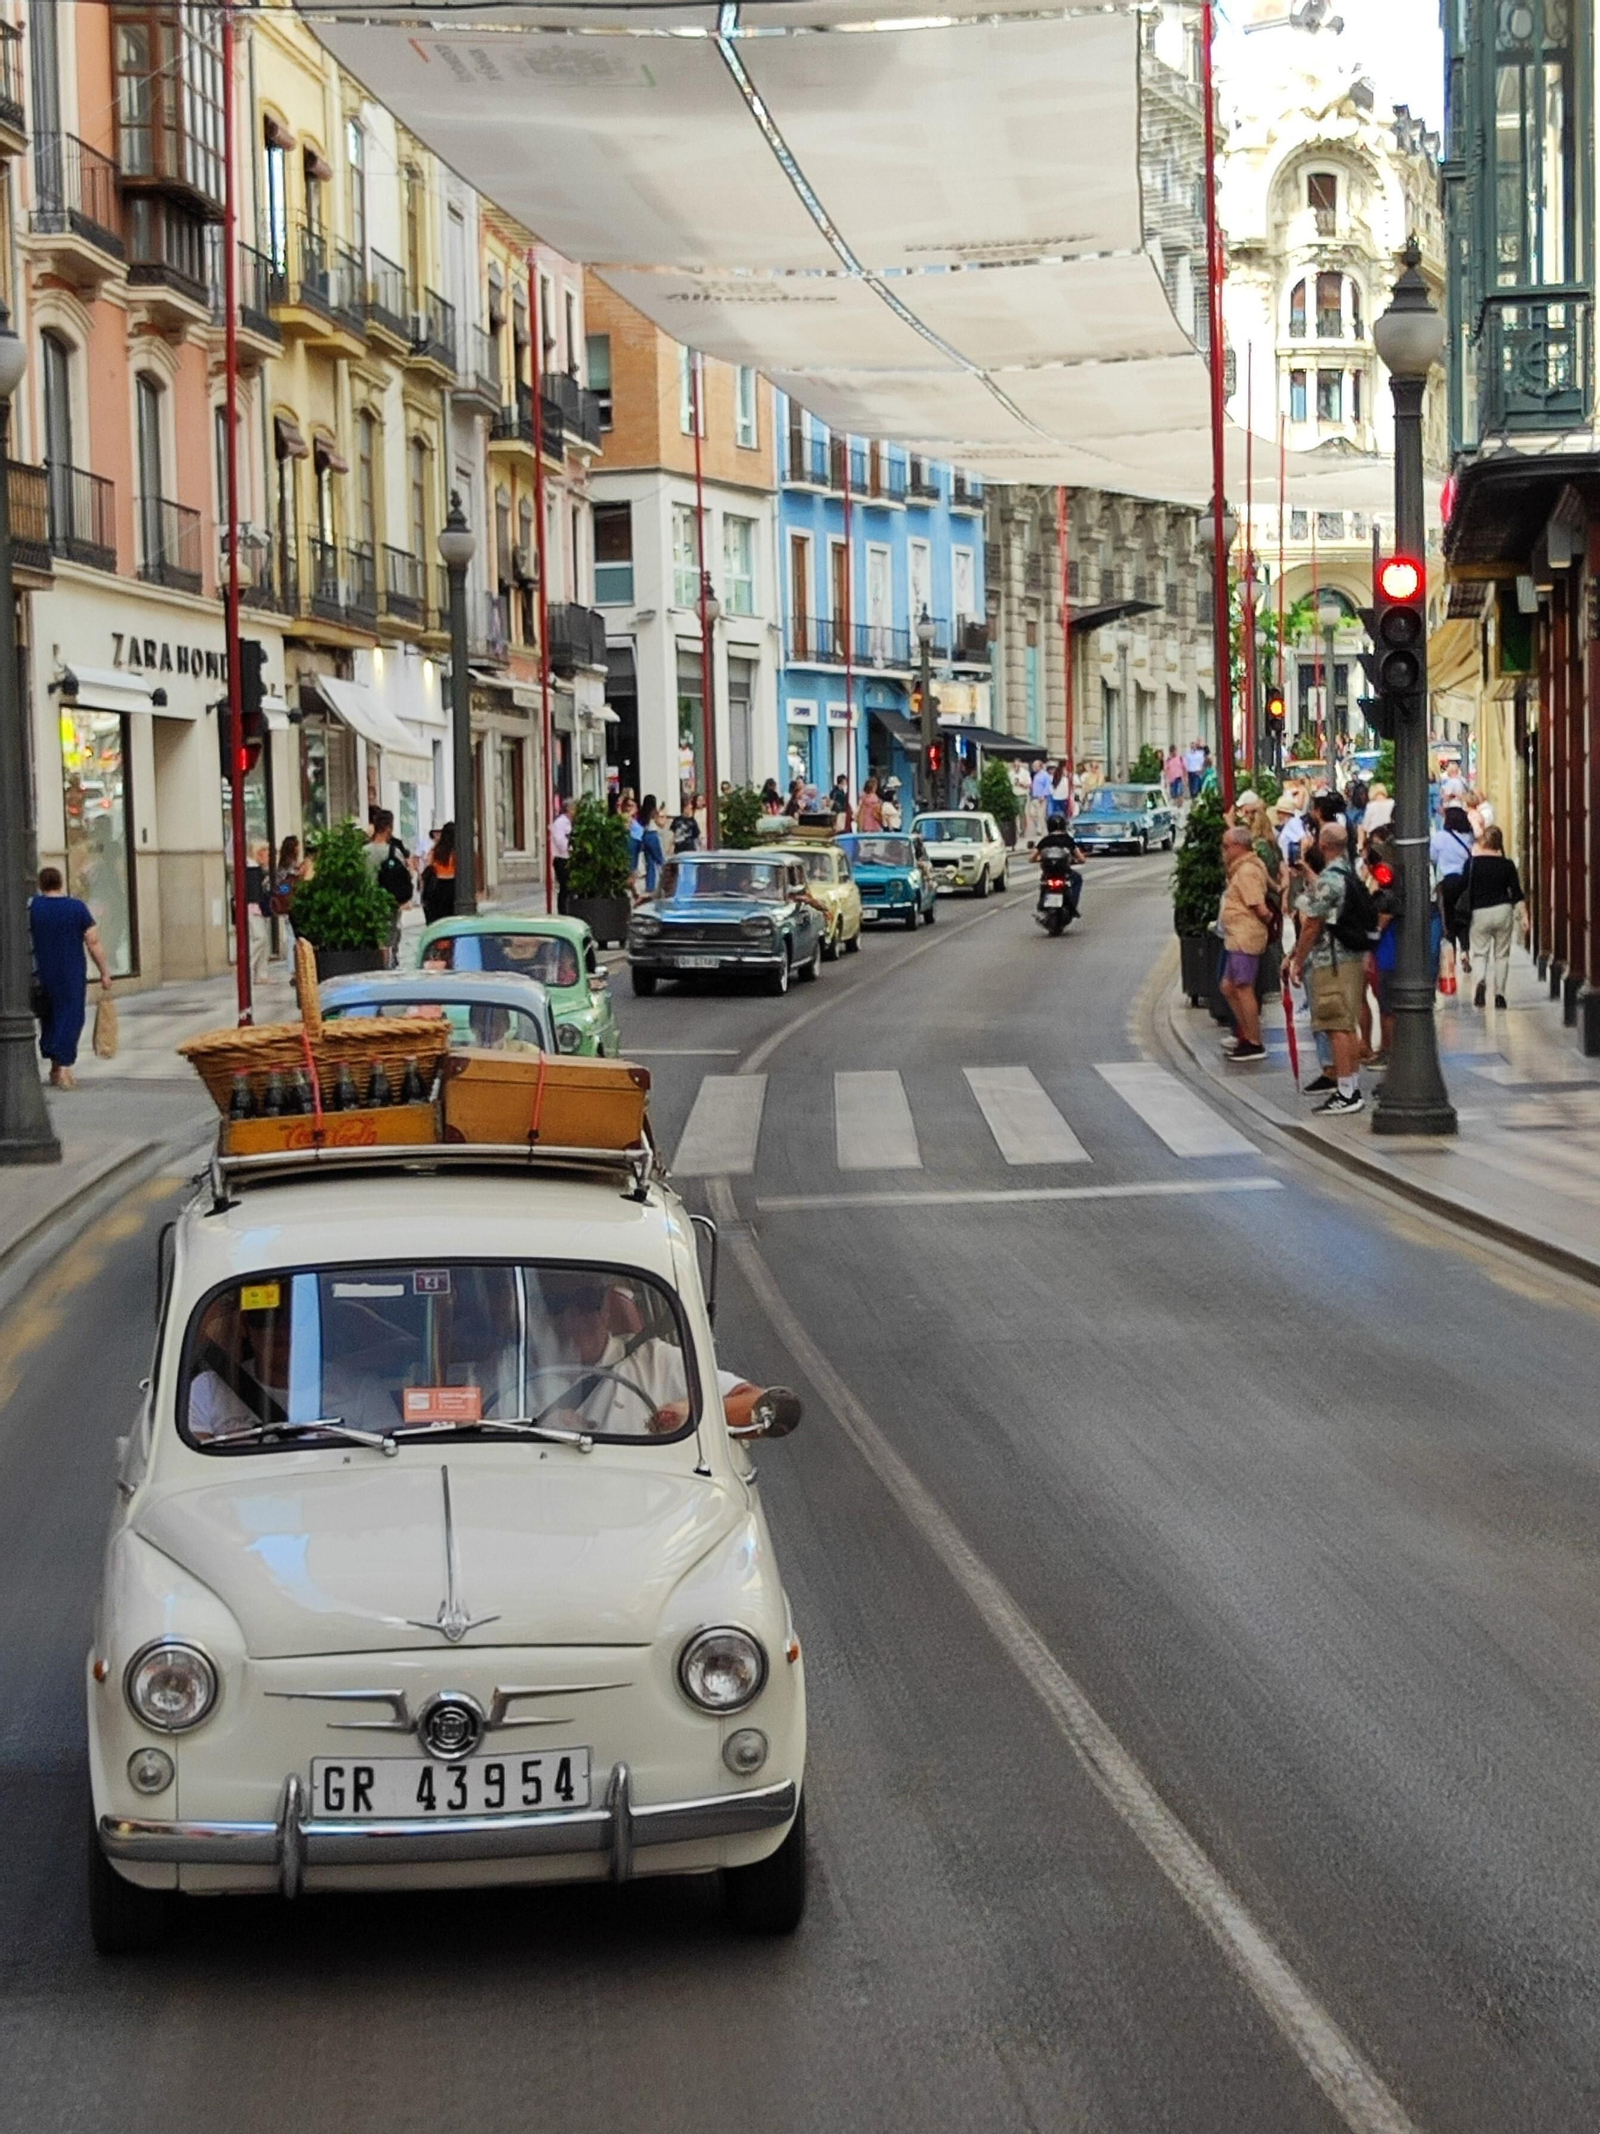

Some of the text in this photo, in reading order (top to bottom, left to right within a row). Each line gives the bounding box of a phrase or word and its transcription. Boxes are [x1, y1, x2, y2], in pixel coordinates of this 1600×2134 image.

[112, 632, 173, 672] ZARA
[324, 1757, 575, 1812] GR 43954
